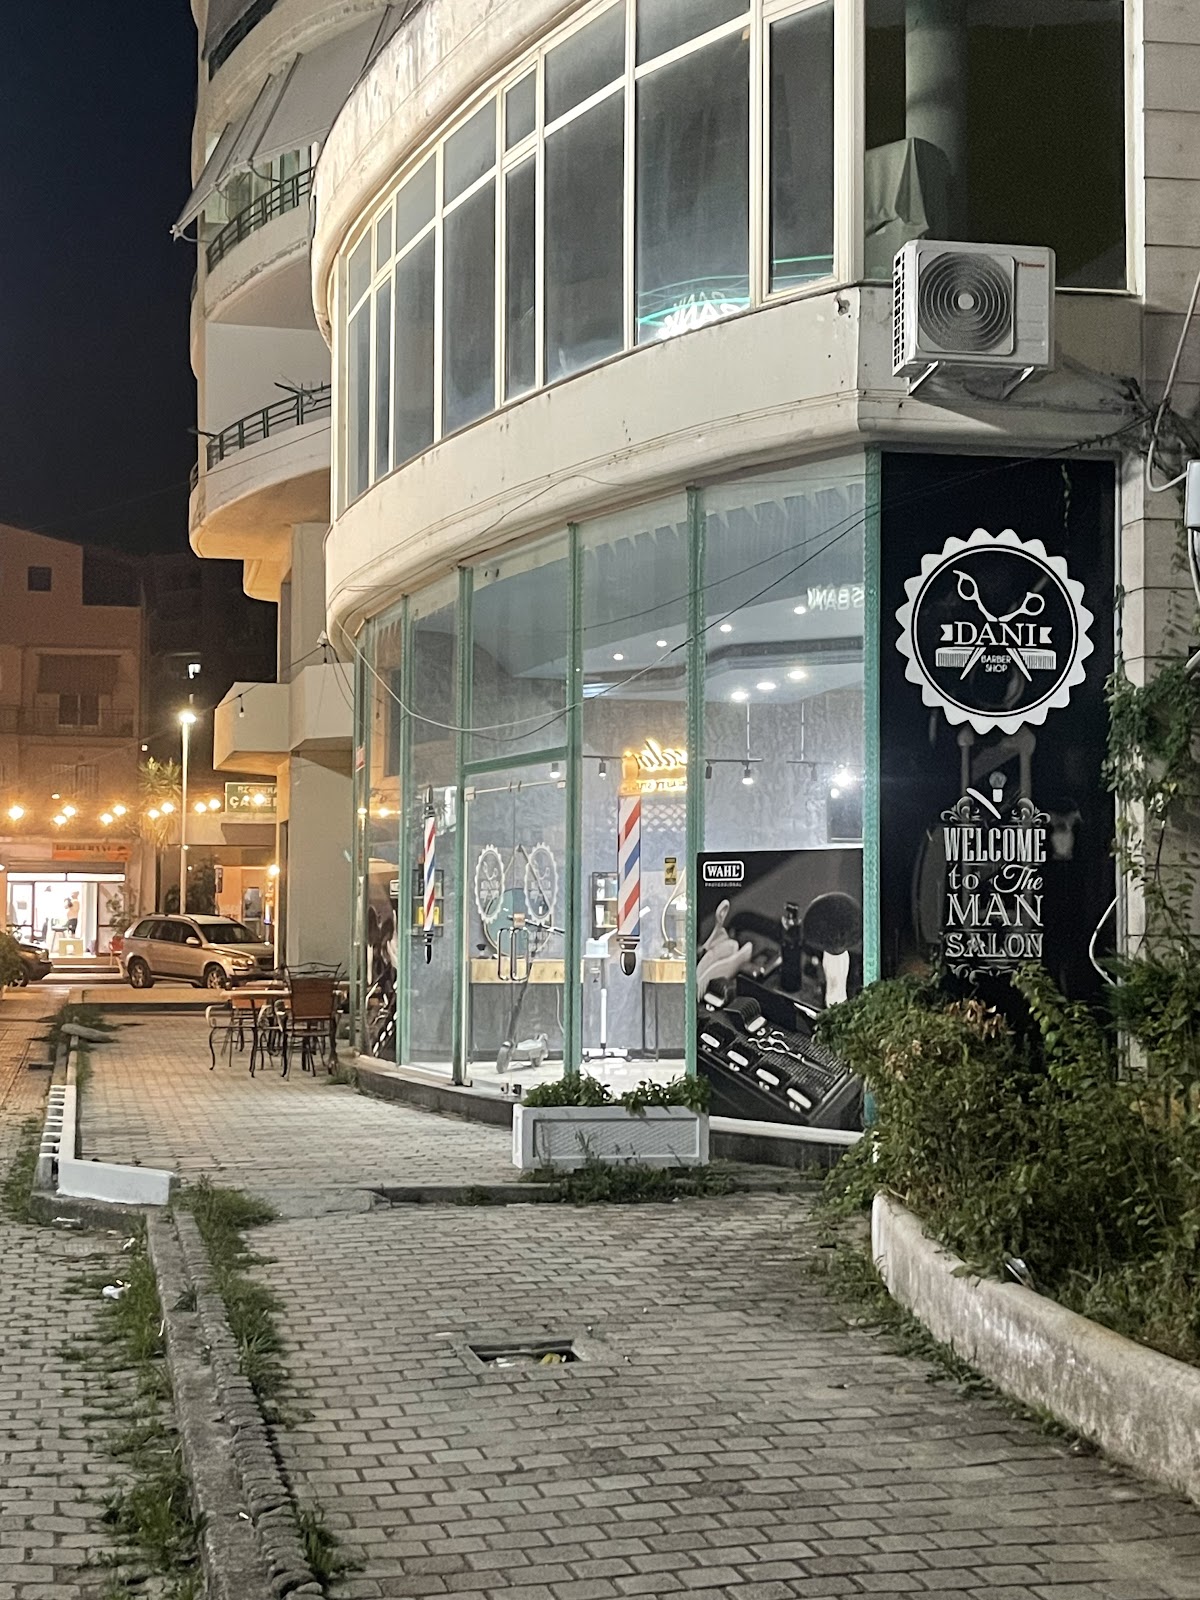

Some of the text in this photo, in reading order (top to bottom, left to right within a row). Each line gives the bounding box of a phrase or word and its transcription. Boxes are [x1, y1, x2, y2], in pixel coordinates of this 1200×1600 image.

[954, 621, 1037, 647] DANI
[981, 655, 1012, 664] BARBER
[985, 664, 1008, 673] SHOP
[943, 827, 1047, 863] WELCOME
[707, 865, 740, 878] WAHL
[948, 864, 1044, 893] to The
[945, 893, 1045, 927] MAN
[945, 932, 1044, 958] SALON
